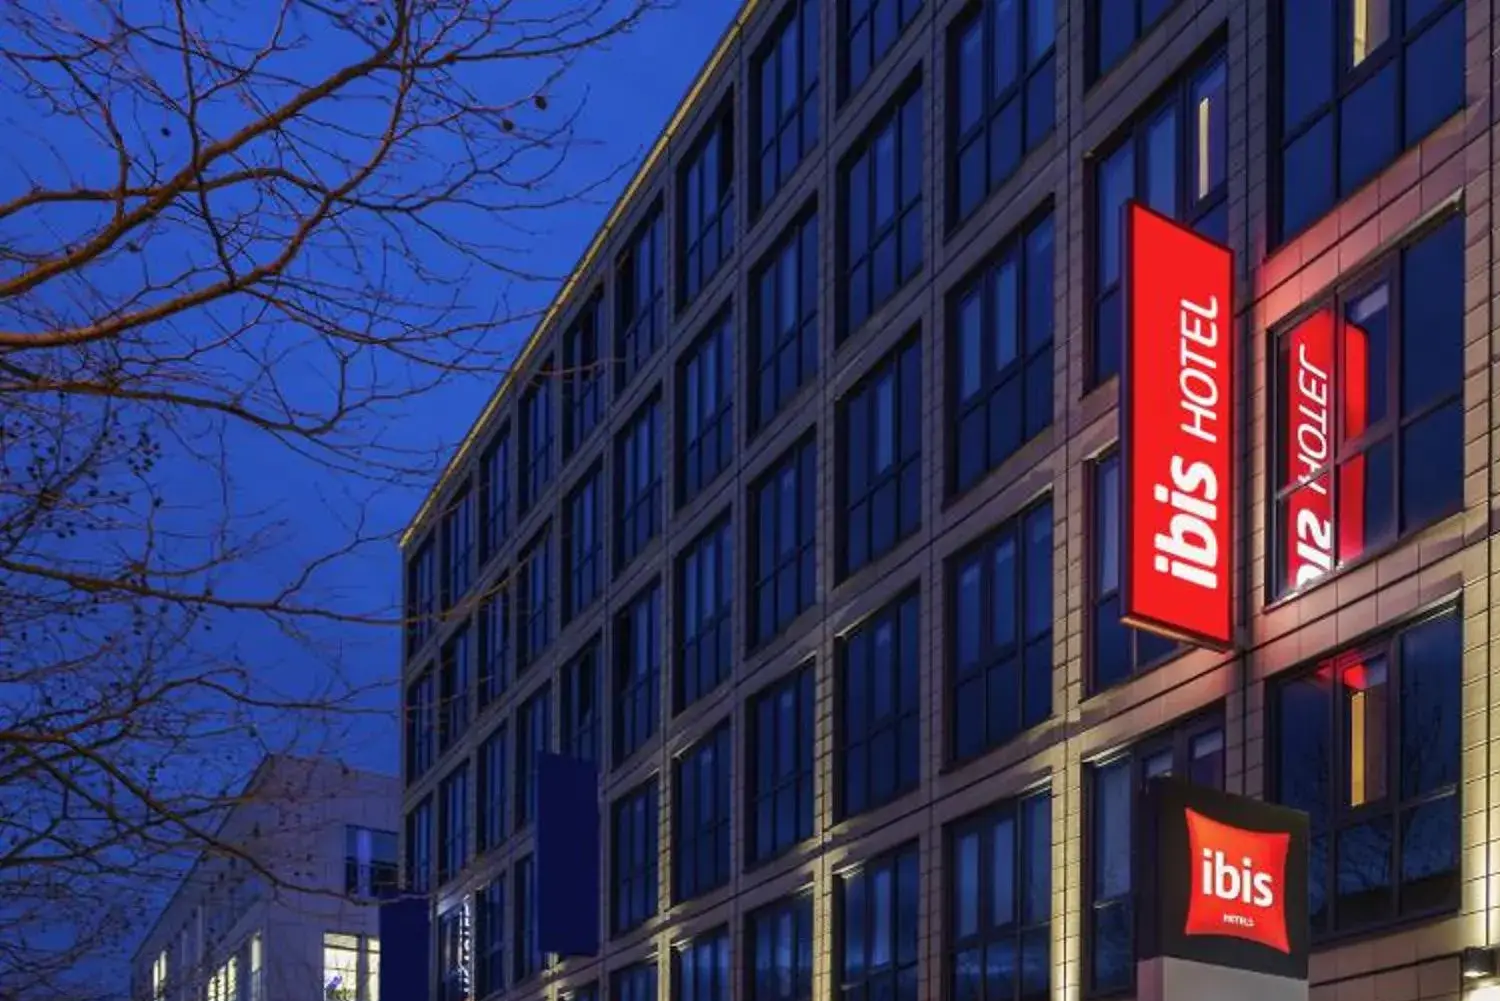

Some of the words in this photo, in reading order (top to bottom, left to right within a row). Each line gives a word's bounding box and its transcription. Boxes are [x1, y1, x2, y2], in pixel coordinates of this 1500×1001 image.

[1180, 295, 1219, 442] HOTEL
[1154, 455, 1219, 588] ibis
[1202, 847, 1273, 907] ibis
